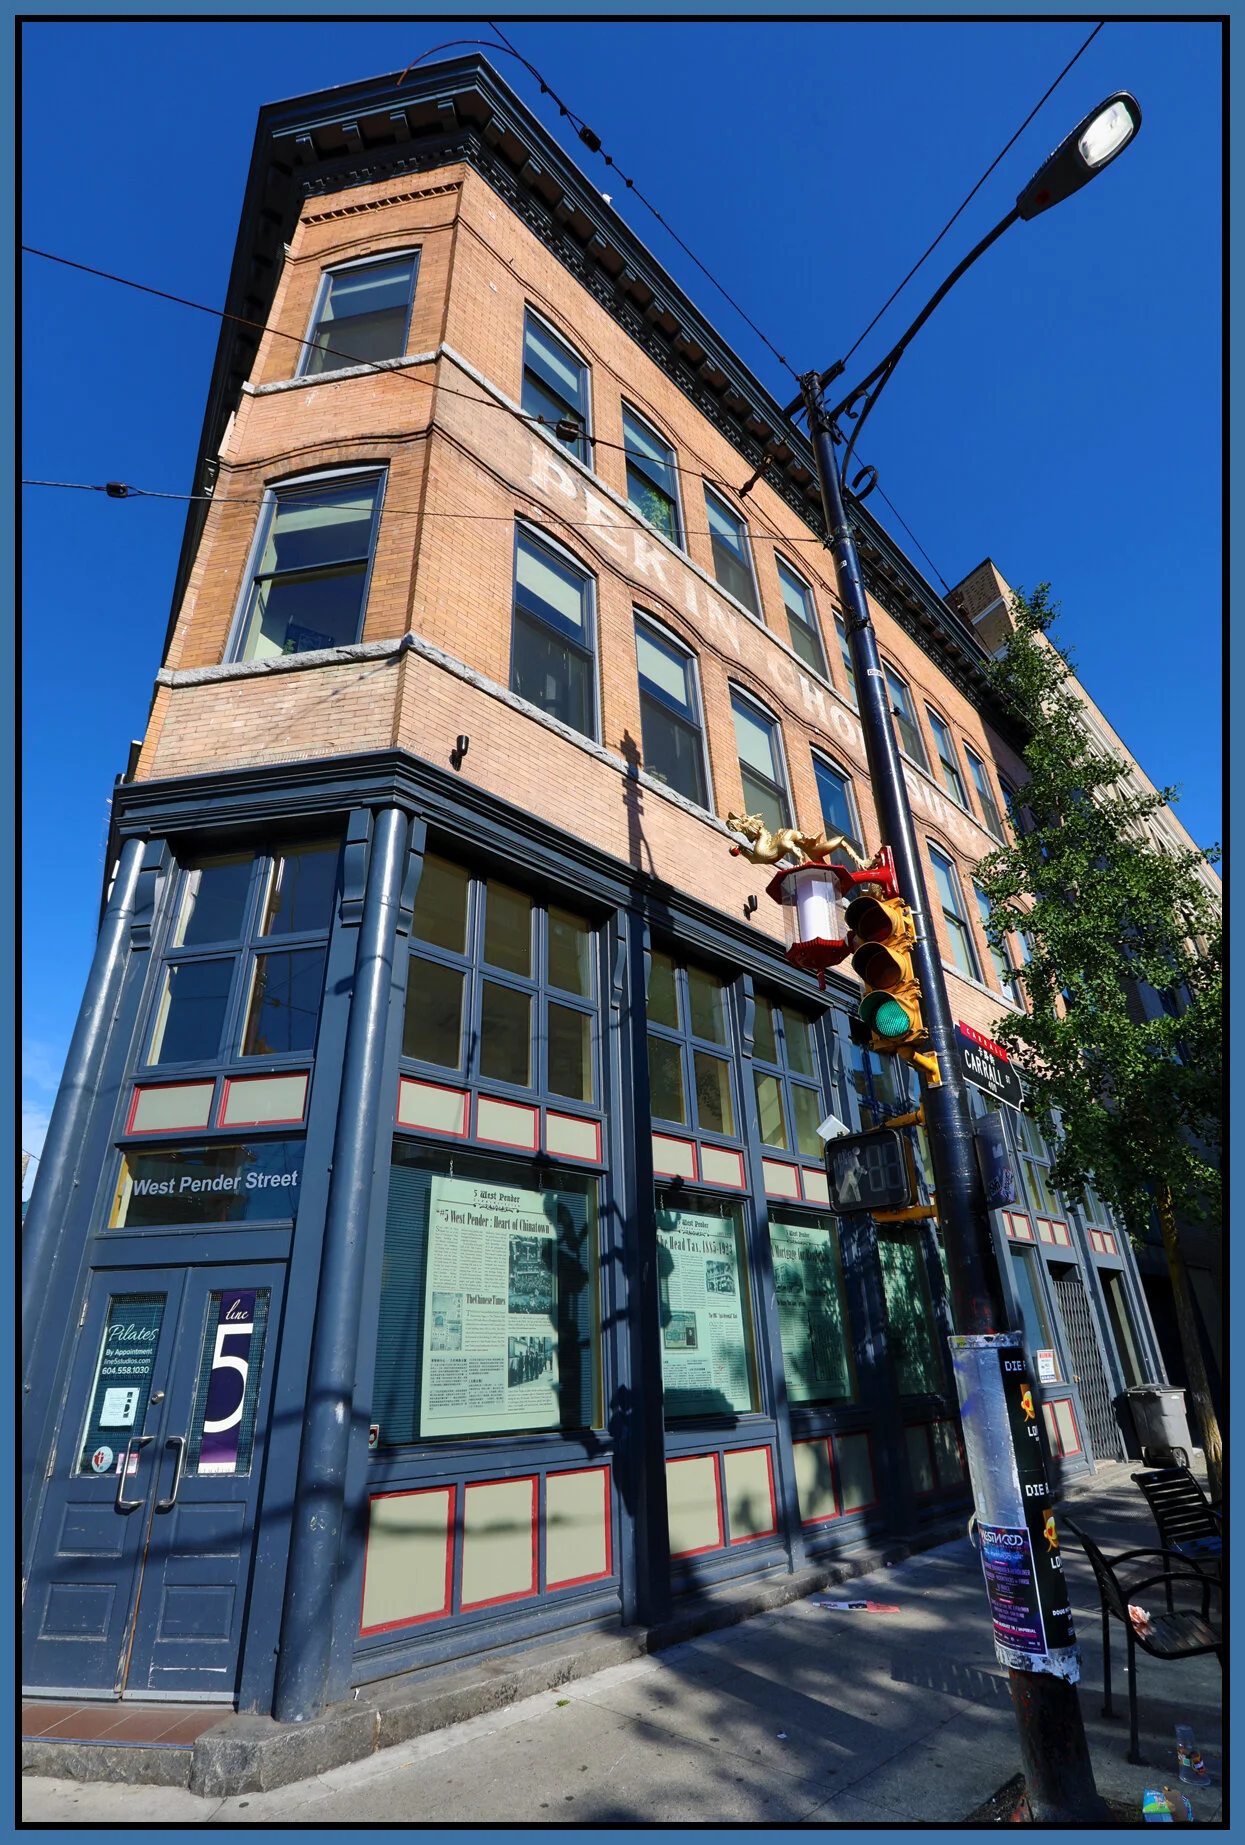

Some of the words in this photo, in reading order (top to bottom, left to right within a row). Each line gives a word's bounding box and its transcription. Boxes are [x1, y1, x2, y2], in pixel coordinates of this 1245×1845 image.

[767, 654, 868, 758] CHO
[966, 1028, 1003, 1057] CARRALL
[964, 1049, 1005, 1089] CARRALL
[133, 1178, 175, 1196] West
[179, 1174, 242, 1193] Pender
[245, 1170, 298, 1189] Street
[473, 1189, 478, 1197] 5
[480, 1190, 497, 1200] West
[499, 1193, 520, 1203] Pender
[450, 1210, 465, 1225] West
[467, 1211, 489, 1227] Pender
[494, 1216, 510, 1230] Heart
[510, 1219, 519, 1231] of
[669, 1236, 685, 1251] Head
[466, 1293, 474, 1304] The
[474, 1294, 492, 1305] Chinese
[492, 1294, 506, 1306] Times
[108, 1323, 160, 1342] Pilates
[106, 1349, 114, 1357] By
[114, 1348, 153, 1356] Appointment
[104, 1357, 151, 1365] line5studios.com
[1004, 1361, 1022, 1372] DIE
[101, 1366, 150, 1375] 604.558.1030
[203, 1323, 254, 1434] 5
[1025, 1484, 1044, 1497] DIE
